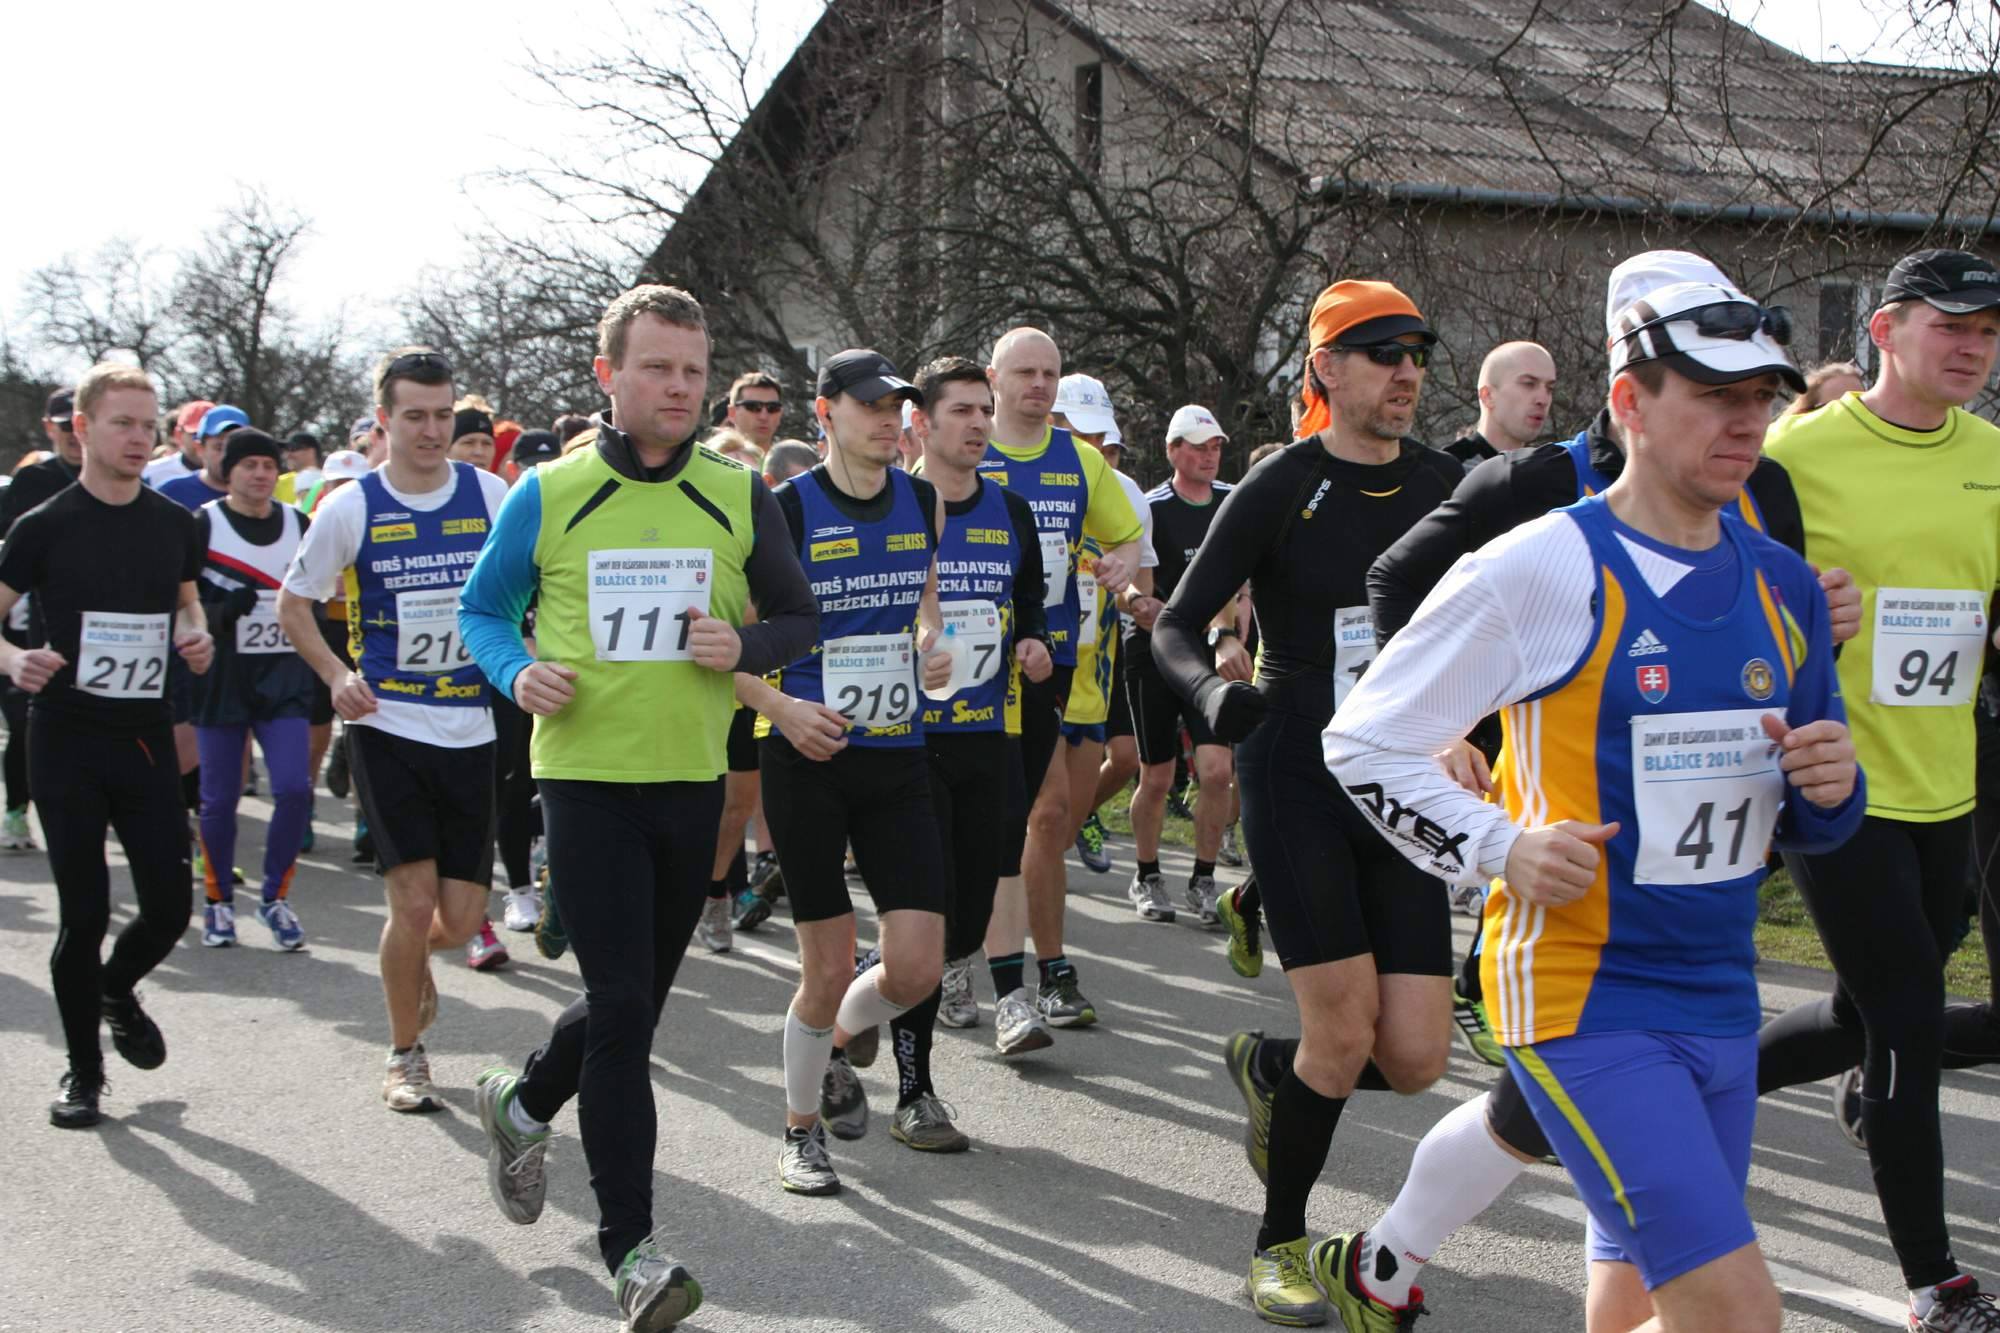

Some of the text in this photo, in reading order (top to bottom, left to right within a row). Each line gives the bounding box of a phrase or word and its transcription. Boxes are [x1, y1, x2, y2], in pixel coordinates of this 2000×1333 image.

[1056, 473, 1079, 486] KISS
[460, 518, 486, 533] KISS
[1044, 516, 1069, 528] LIGA
[904, 533, 927, 550] KISS
[984, 529, 1009, 545] KISS
[371, 555, 402, 573] ORŠ
[384, 568, 450, 589] BEŽECKÁ
[595, 573, 667, 586] BLAŽICE 2014
[811, 567, 928, 596] ORŠ MOLDAVSKÁ
[974, 579, 1003, 593] LIGA
[822, 590, 920, 613] BEŽECKÁ LIGA
[602, 607, 692, 651] 111
[1882, 613, 1951, 628] BLAŽICE 2014
[1628, 645, 1669, 657] adidas
[828, 654, 885, 668] BLAŽICE 2014
[86, 656, 163, 691] 212
[1894, 649, 1959, 697] 94
[838, 682, 910, 721] 219
[1644, 750, 1743, 771] BLAŽICE 2014
[1675, 798, 1752, 870] 41
[898, 1028, 917, 1082] CRAFT
